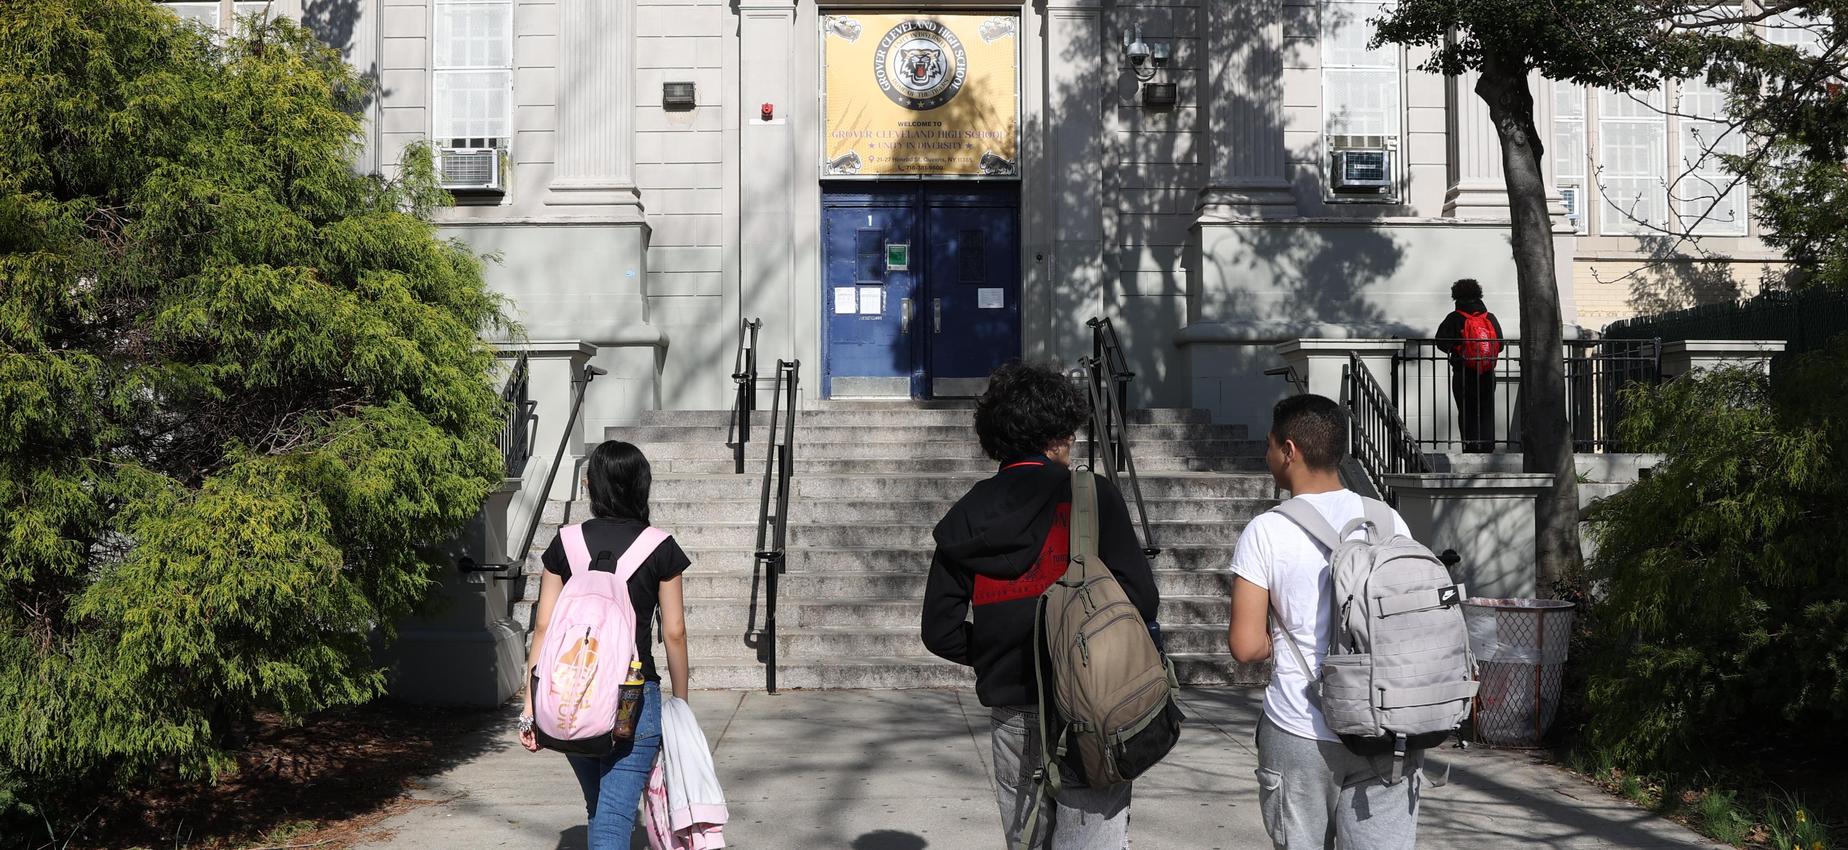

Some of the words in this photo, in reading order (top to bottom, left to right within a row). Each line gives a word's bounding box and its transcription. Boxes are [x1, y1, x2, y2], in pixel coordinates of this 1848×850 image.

[881, 21, 936, 48] CLEVELAND
[938, 26, 960, 49] HIGH
[876, 49, 891, 91] GROVER
[950, 49, 966, 89] SCHOOL
[832, 130, 873, 138] GROVER
[876, 130, 935, 138] CLEVELAND
[938, 130, 962, 138] HIGH
[964, 130, 1005, 138] SCHOOL
[867, 215, 873, 226] 1
